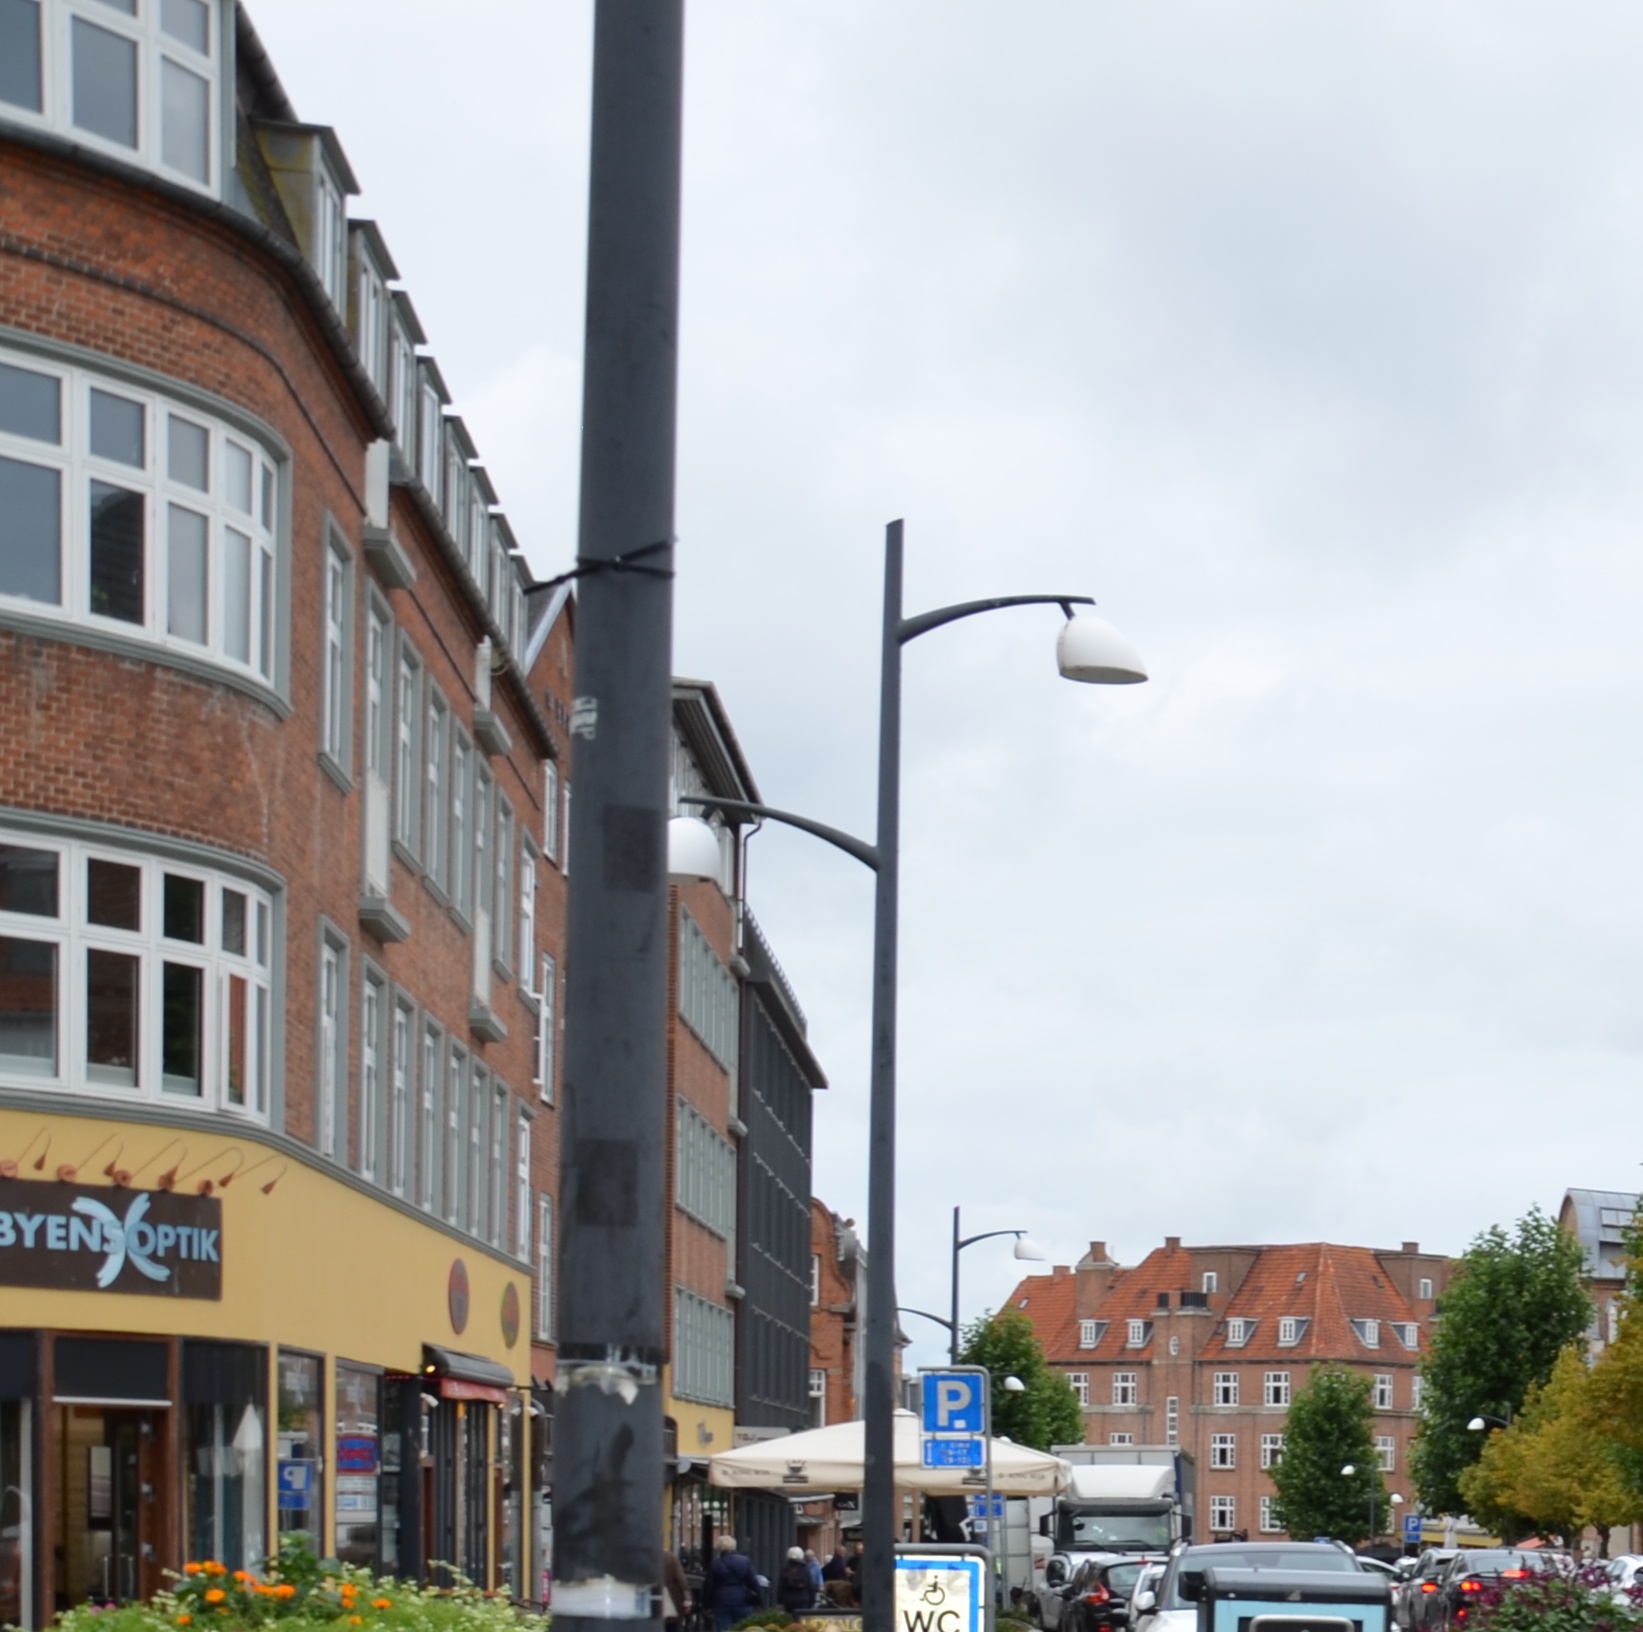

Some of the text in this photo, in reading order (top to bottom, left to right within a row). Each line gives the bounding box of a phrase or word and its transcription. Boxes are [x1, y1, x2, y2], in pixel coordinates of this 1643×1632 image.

[0, 1211, 219, 1262] BYENS OPTIK
[937, 1380, 972, 1427] P
[1408, 1518, 1418, 1530] P
